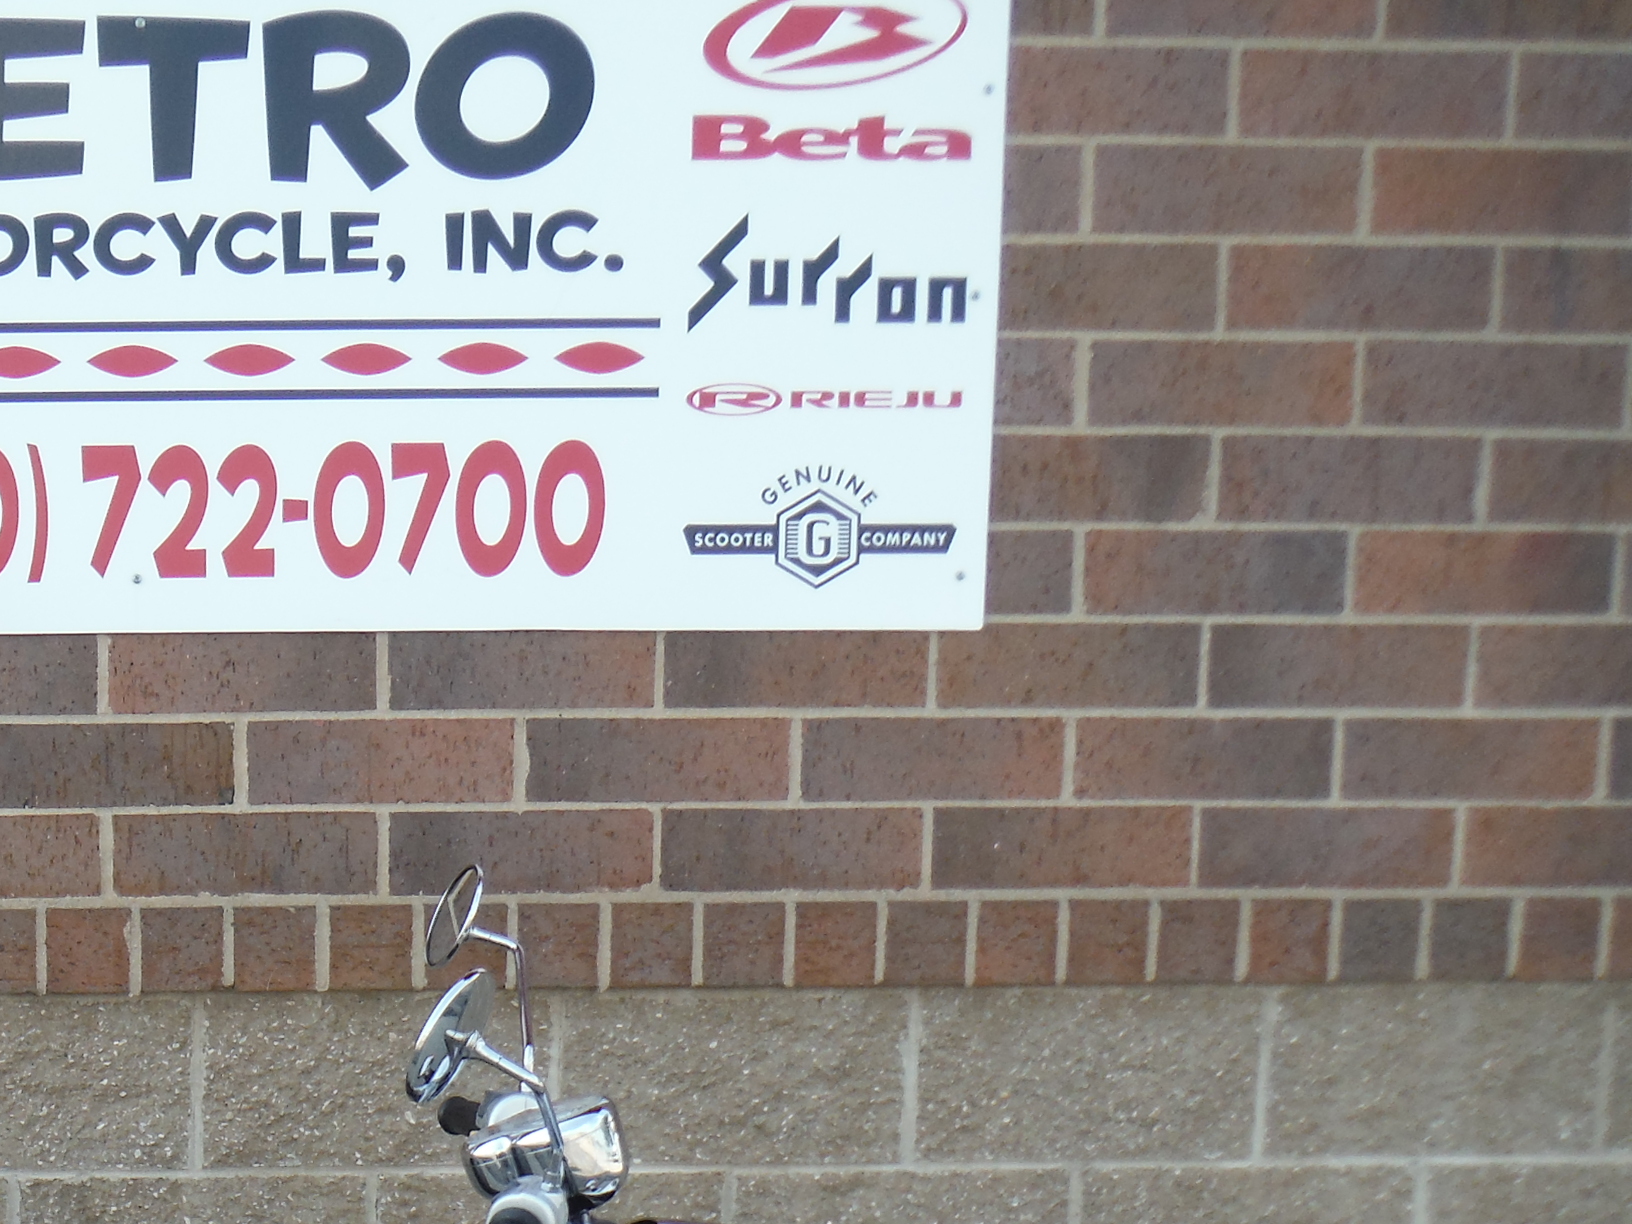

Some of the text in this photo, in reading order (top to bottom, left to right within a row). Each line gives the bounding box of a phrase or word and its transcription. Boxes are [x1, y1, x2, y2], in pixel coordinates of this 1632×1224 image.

[691, 114, 972, 161] Beta
[445, 209, 624, 273] INC.
[790, 390, 963, 409] RIEJU
[761, 464, 879, 508] GENUINE
[81, 439, 606, 579] 722-0700
[694, 532, 774, 549] SCOOTER
[860, 531, 948, 548] COMPANY
